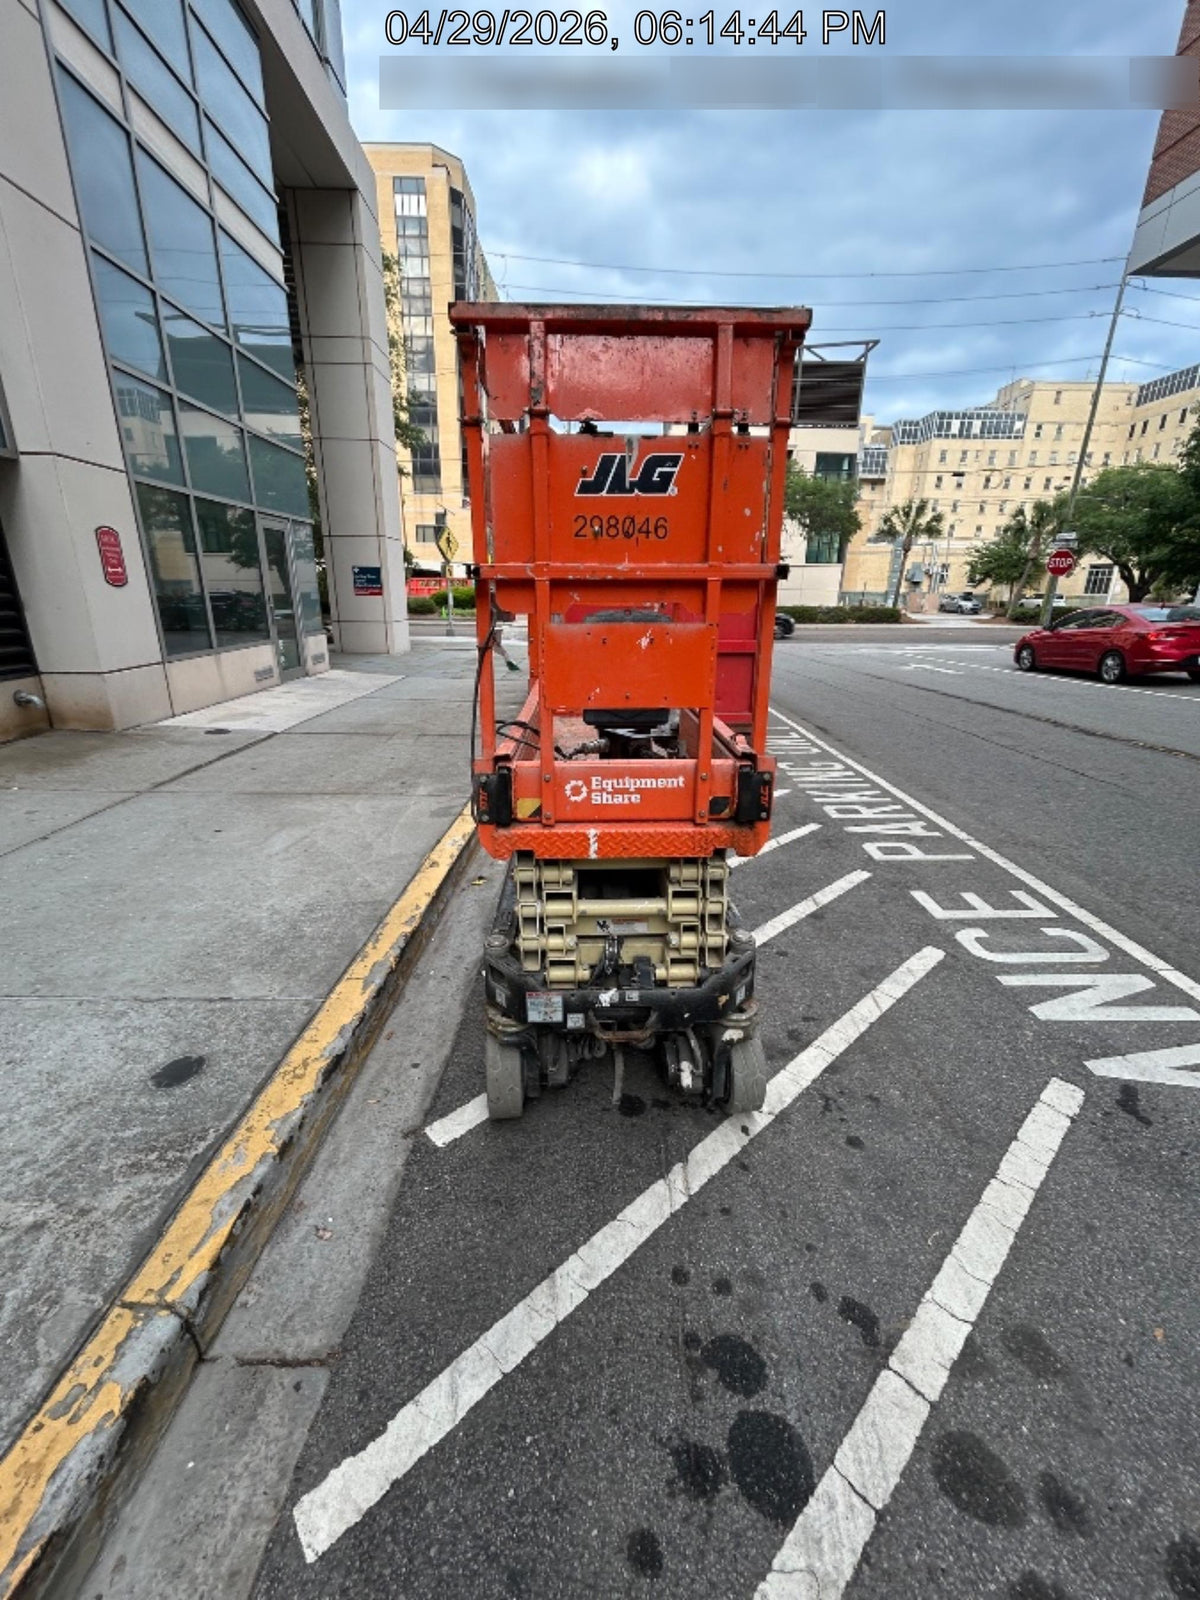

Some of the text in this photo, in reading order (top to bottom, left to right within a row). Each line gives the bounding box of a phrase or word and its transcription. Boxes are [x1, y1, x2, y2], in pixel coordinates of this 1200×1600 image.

[574, 452, 685, 496] JLG
[573, 515, 668, 539] 298046
[1048, 557, 1073, 568] STOP
[590, 775, 685, 792] Equipment
[590, 791, 641, 804] Share
[776, 762, 975, 861] PARKING
